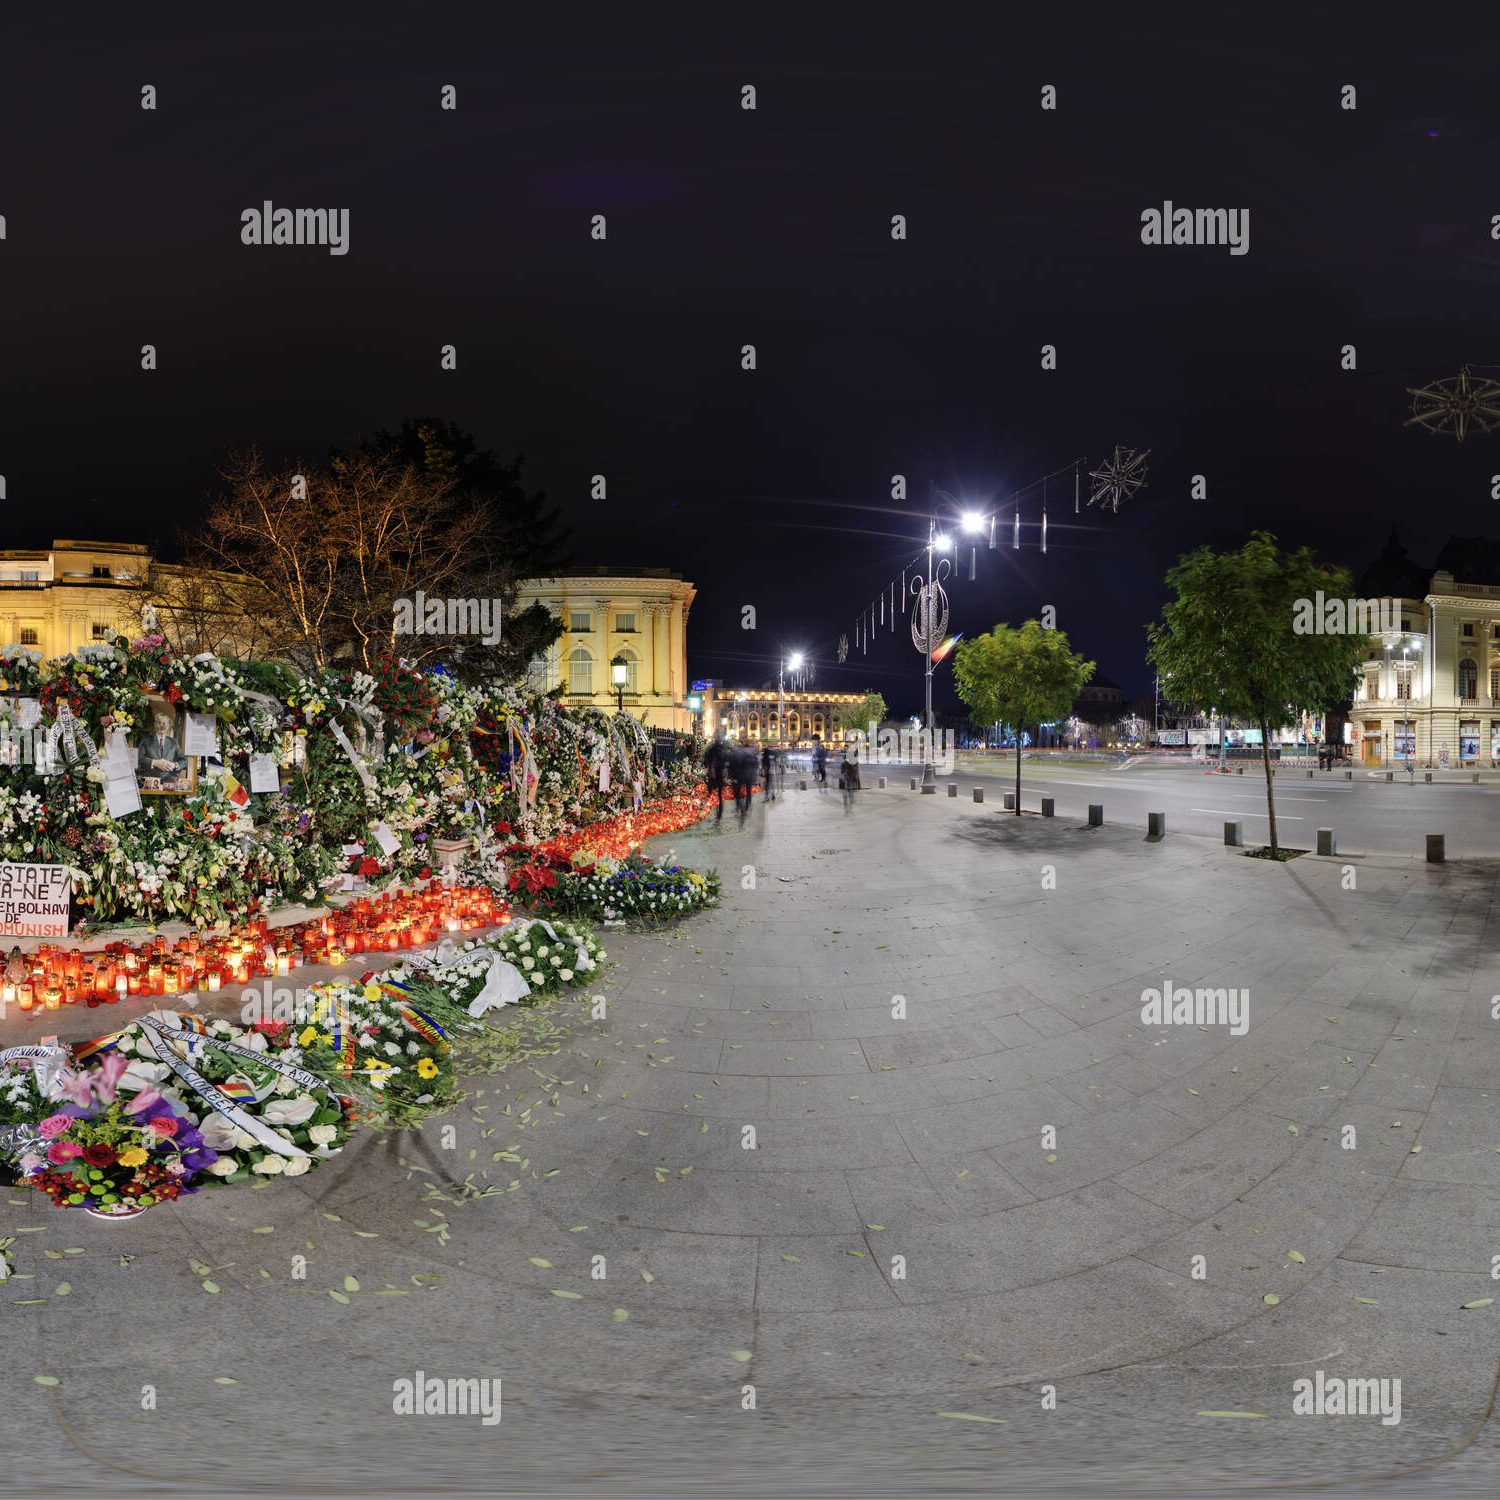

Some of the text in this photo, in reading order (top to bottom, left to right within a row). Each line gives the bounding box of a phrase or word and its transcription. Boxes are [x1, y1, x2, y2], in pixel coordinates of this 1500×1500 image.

[18, 902, 69, 915] BOLNAVI
[5, 913, 21, 924] DE
[154, 1042, 238, 1114] VICTOR CIORBEA
